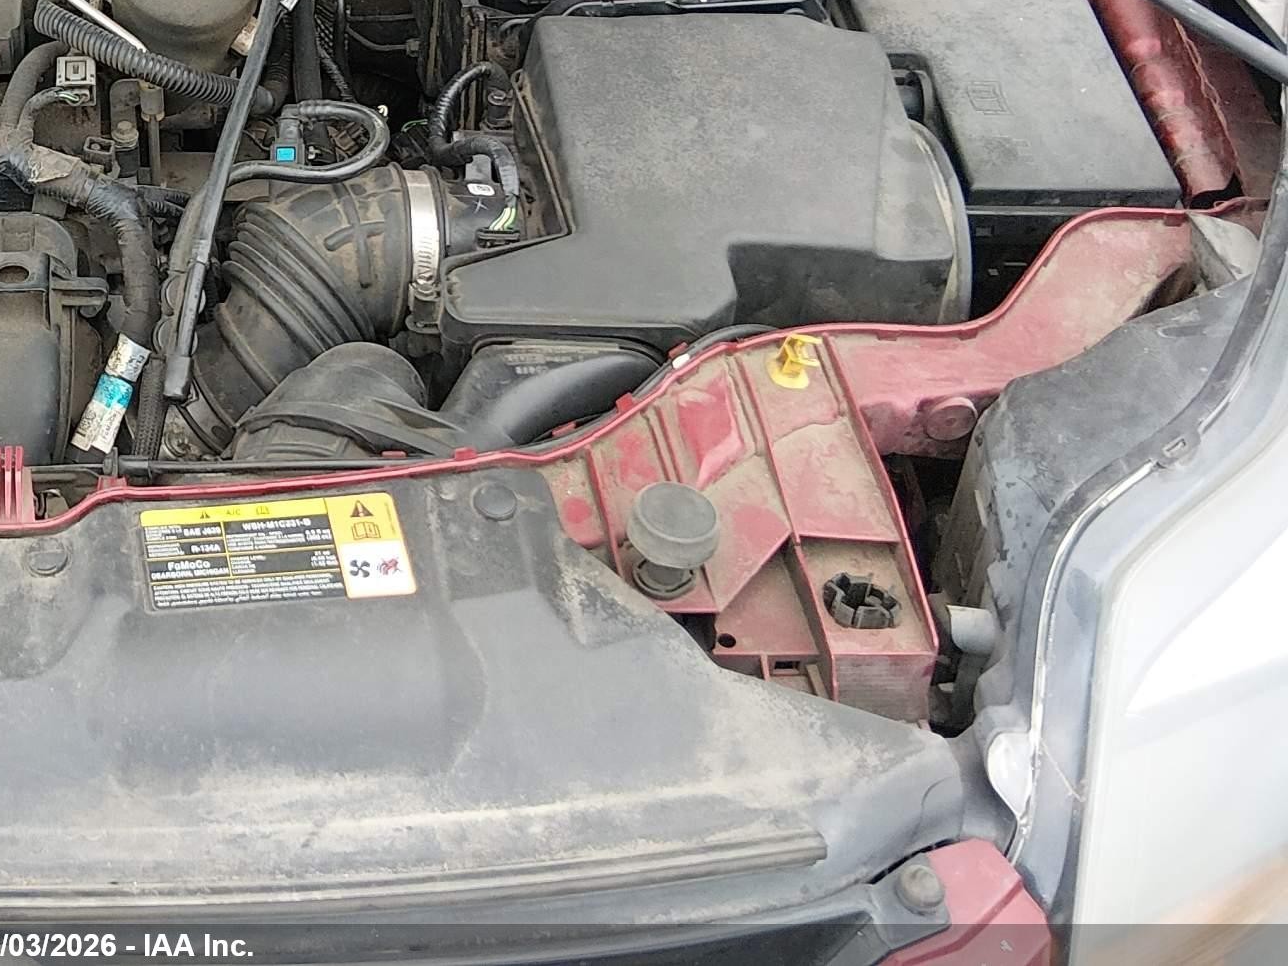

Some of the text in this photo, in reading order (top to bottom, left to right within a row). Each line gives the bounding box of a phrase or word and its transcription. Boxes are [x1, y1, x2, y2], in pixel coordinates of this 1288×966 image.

[183, 527, 201, 536] SAE
[191, 545, 221, 553] R-134A
[167, 559, 211, 571] FoMoCo
